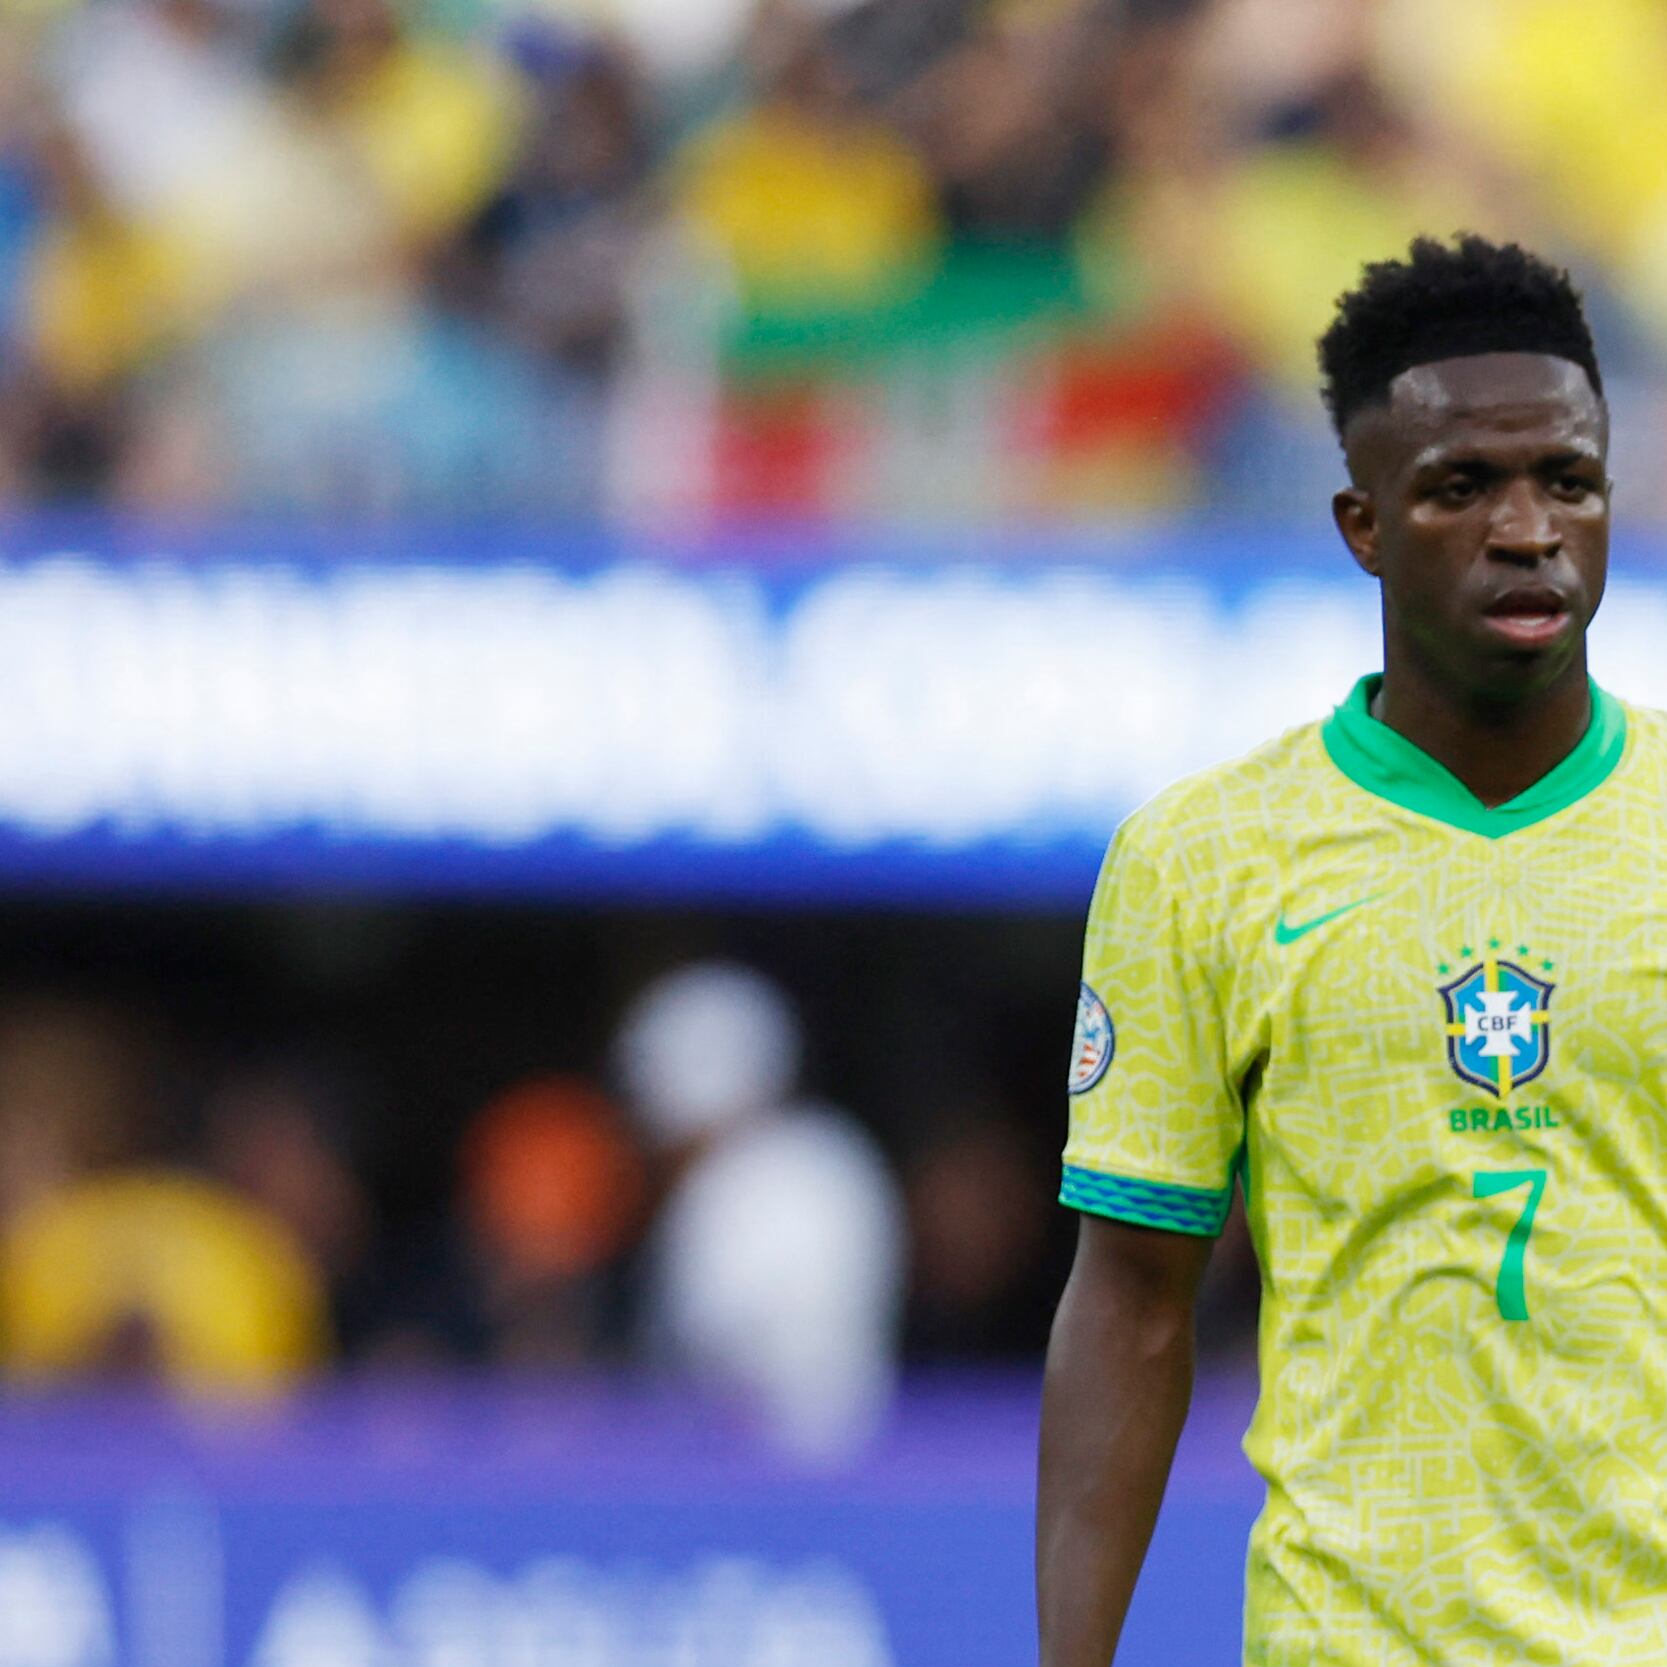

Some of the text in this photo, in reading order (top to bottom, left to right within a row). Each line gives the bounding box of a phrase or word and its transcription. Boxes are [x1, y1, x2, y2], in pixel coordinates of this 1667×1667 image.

[1477, 1014, 1519, 1033] CBF
[1450, 1106, 1560, 1133] BRASIL
[1472, 1169, 1548, 1321] 7
